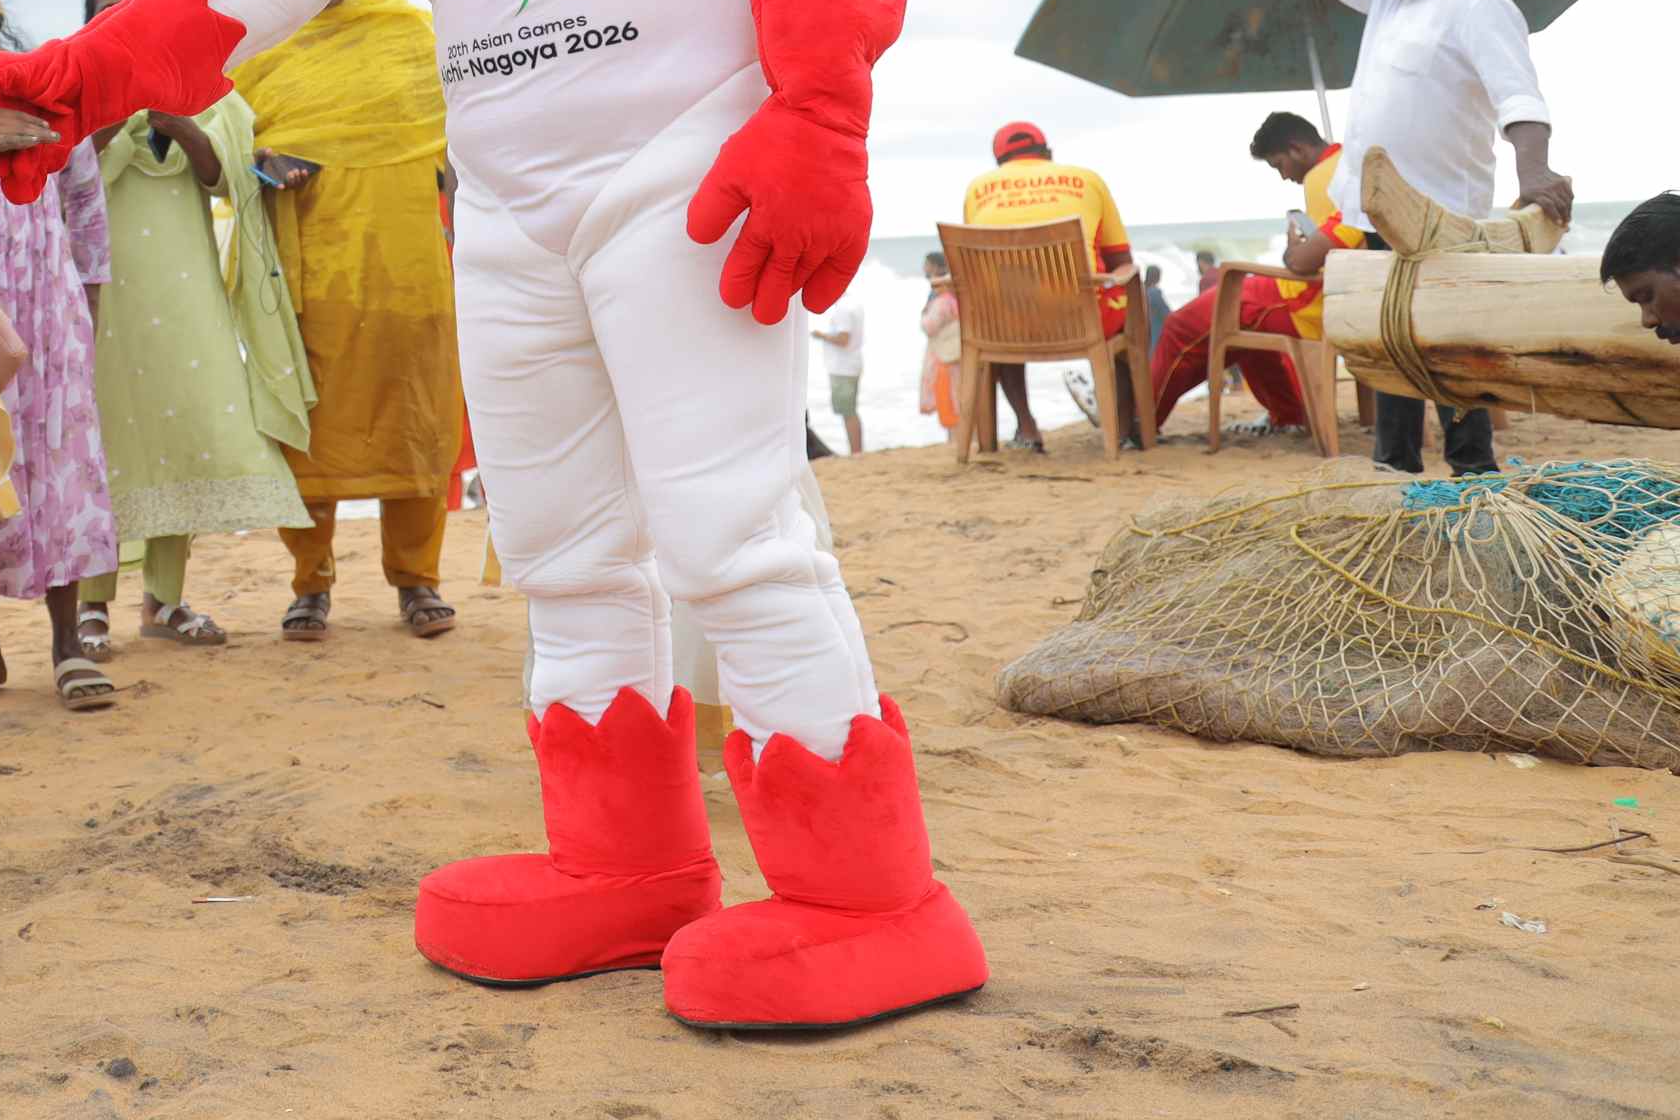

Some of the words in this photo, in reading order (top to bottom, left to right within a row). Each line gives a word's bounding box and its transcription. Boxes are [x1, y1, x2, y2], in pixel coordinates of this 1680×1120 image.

[448, 39, 469, 59] 20th
[472, 31, 513, 53] Asian
[518, 15, 588, 40] Games
[565, 21, 639, 55] 2026
[974, 175, 1085, 200] LIFEGUARD
[996, 195, 1059, 208] KERALA
